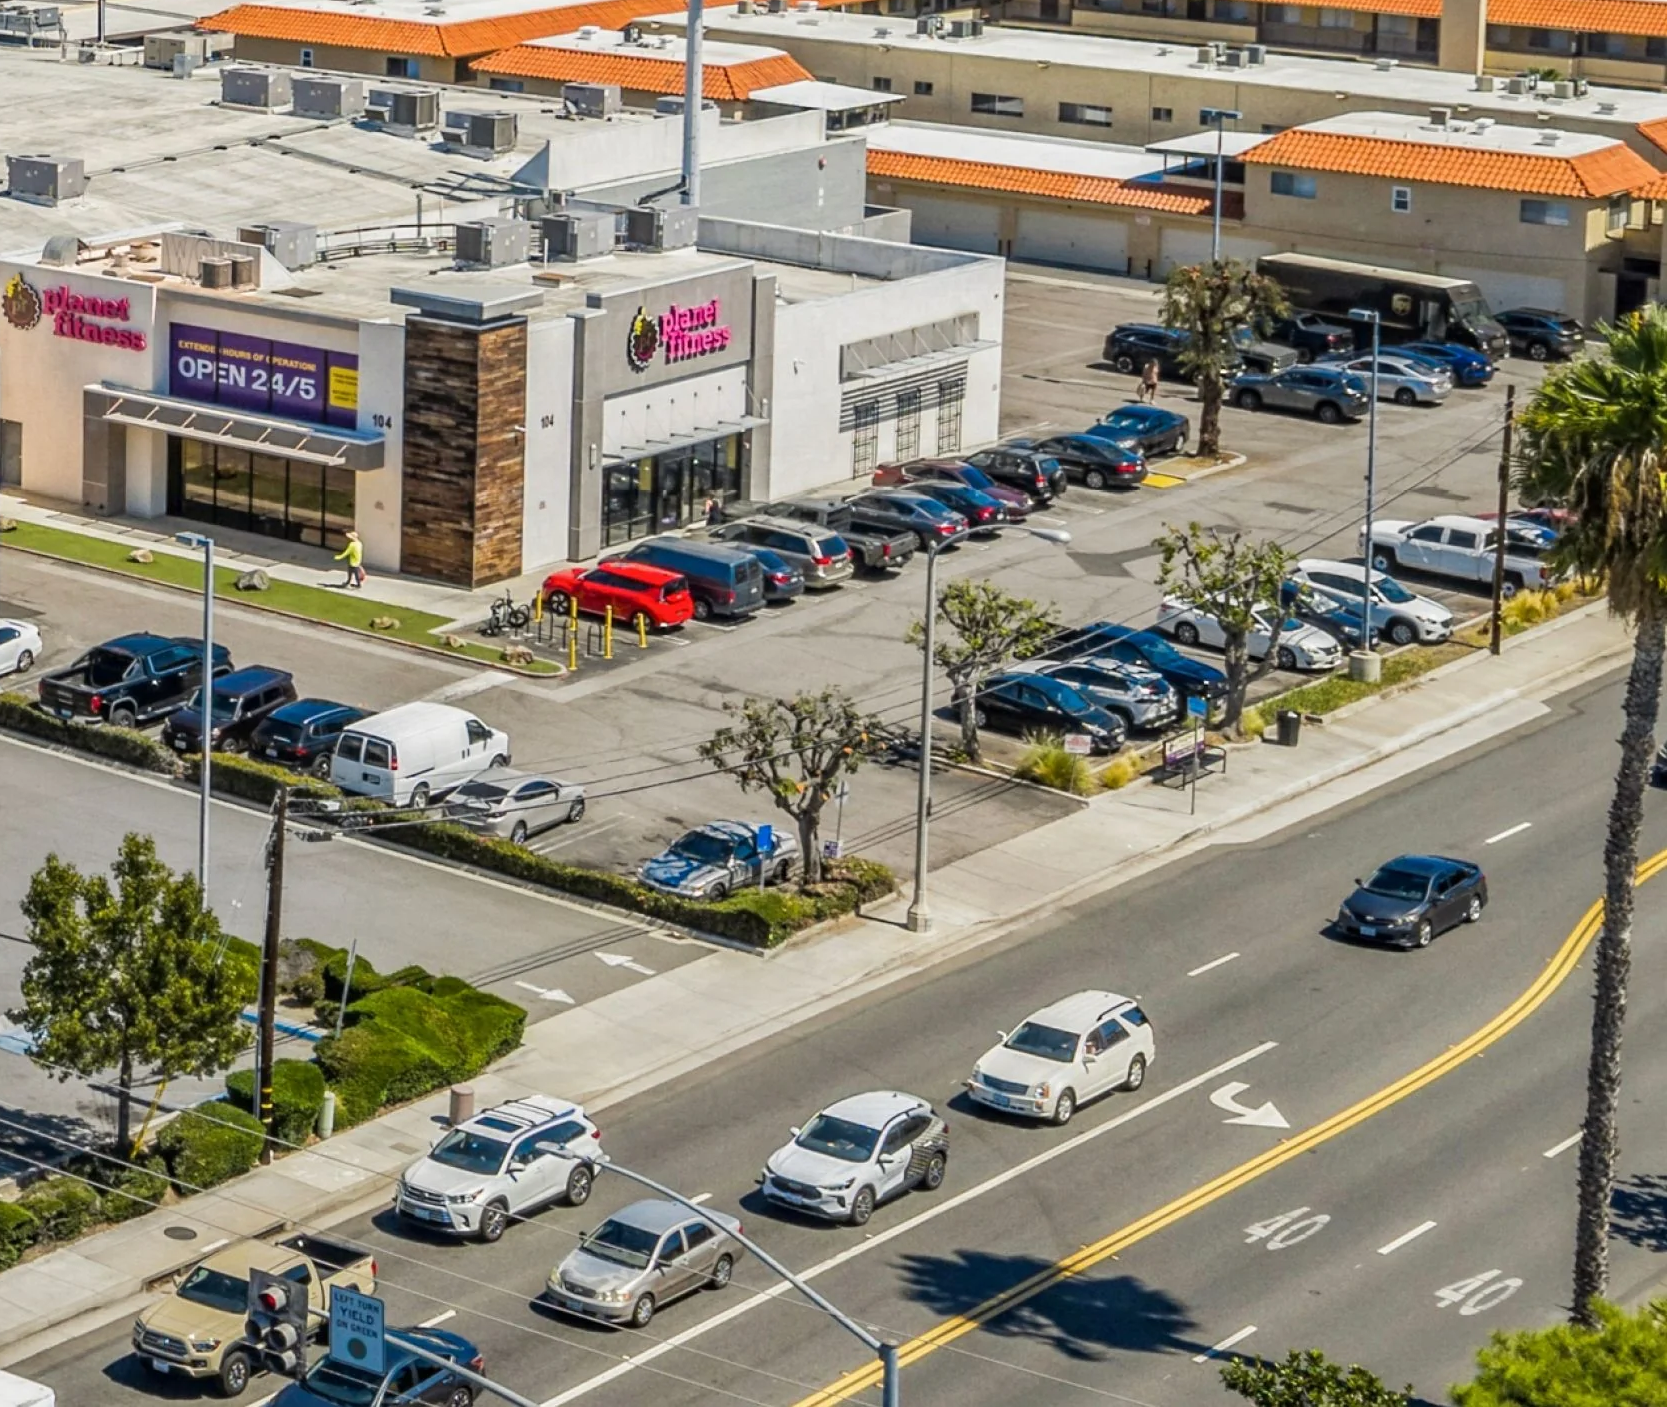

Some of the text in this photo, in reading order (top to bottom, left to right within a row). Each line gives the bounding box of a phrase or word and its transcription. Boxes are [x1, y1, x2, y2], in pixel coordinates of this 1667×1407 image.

[43, 283, 130, 322] planet
[660, 296, 722, 342] planet
[54, 309, 147, 351] fitness
[668, 324, 732, 359] fitness
[178, 339, 221, 355] EXTENDE
[223, 348, 252, 361] HOURS
[253, 352, 264, 363] OF
[178, 355, 247, 388] OPEN
[251, 368, 317, 400] 24/5
[372, 412, 393, 430] 104
[541, 414, 555, 430] 104
[1243, 1206, 1332, 1250] 40
[334, 1291, 380, 1313] LEFT TURN
[1434, 1268, 1524, 1315] 40
[335, 1318, 378, 1339] ON GREEN
[340, 1305, 375, 1326] YIELD
